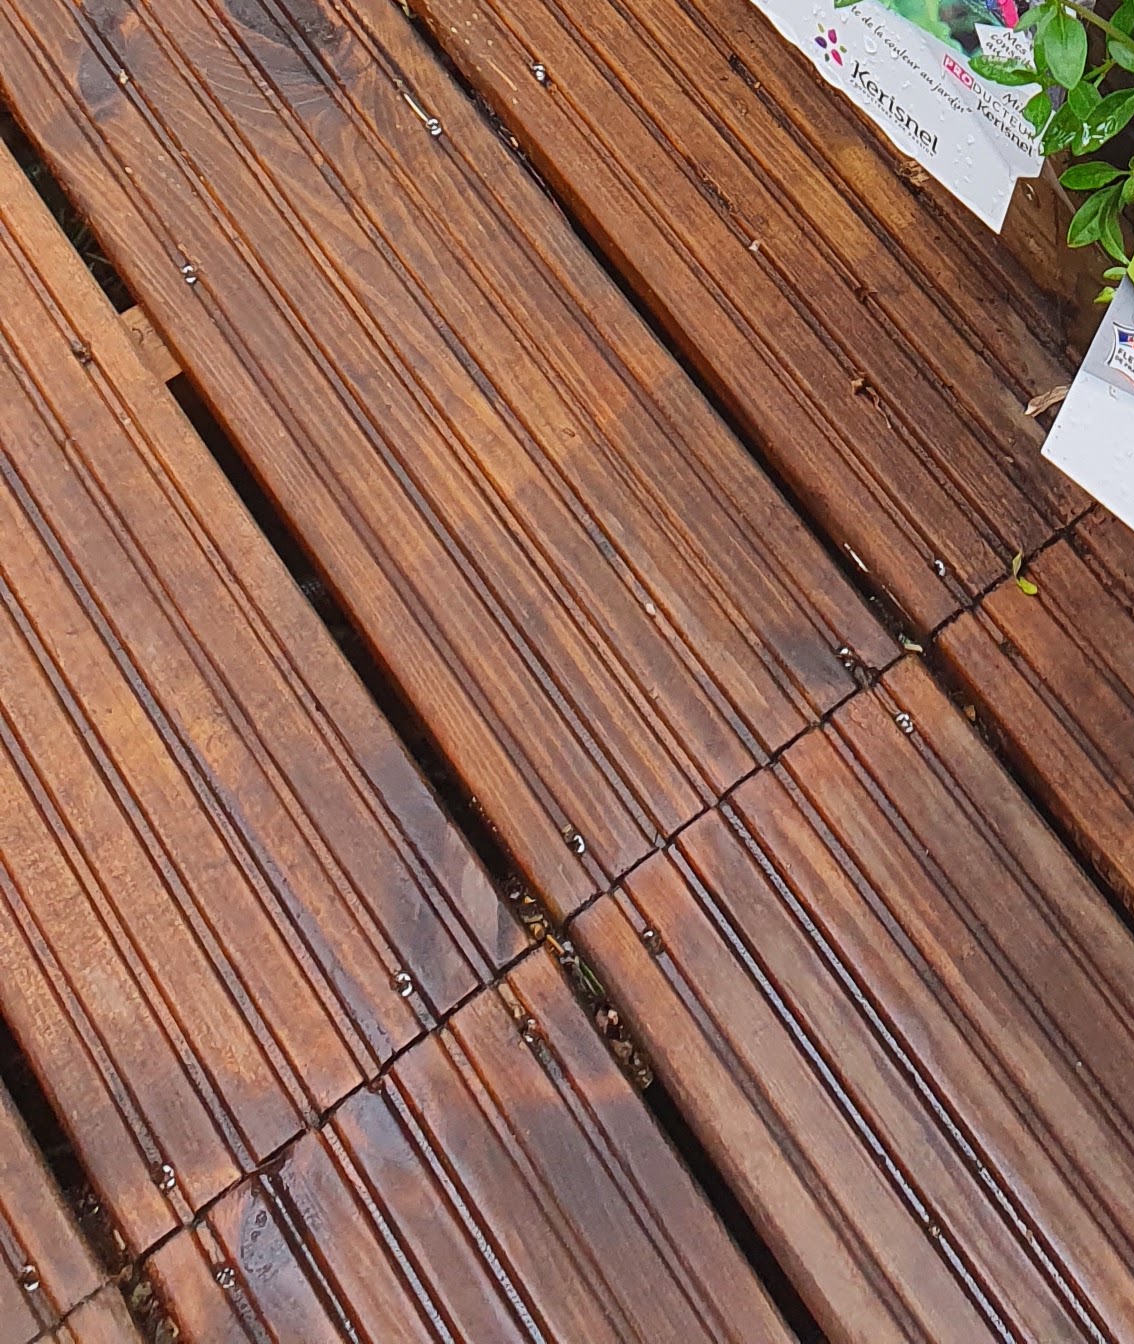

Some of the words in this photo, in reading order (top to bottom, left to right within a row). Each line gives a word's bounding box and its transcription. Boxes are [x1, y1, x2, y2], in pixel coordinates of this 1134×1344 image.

[884, 38, 921, 72] couleur
[919, 70, 934, 86] au
[1002, 32, 1027, 55] Mes
[850, 59, 940, 155] Kerisnel
[976, 98, 1033, 158] Kerisnel
